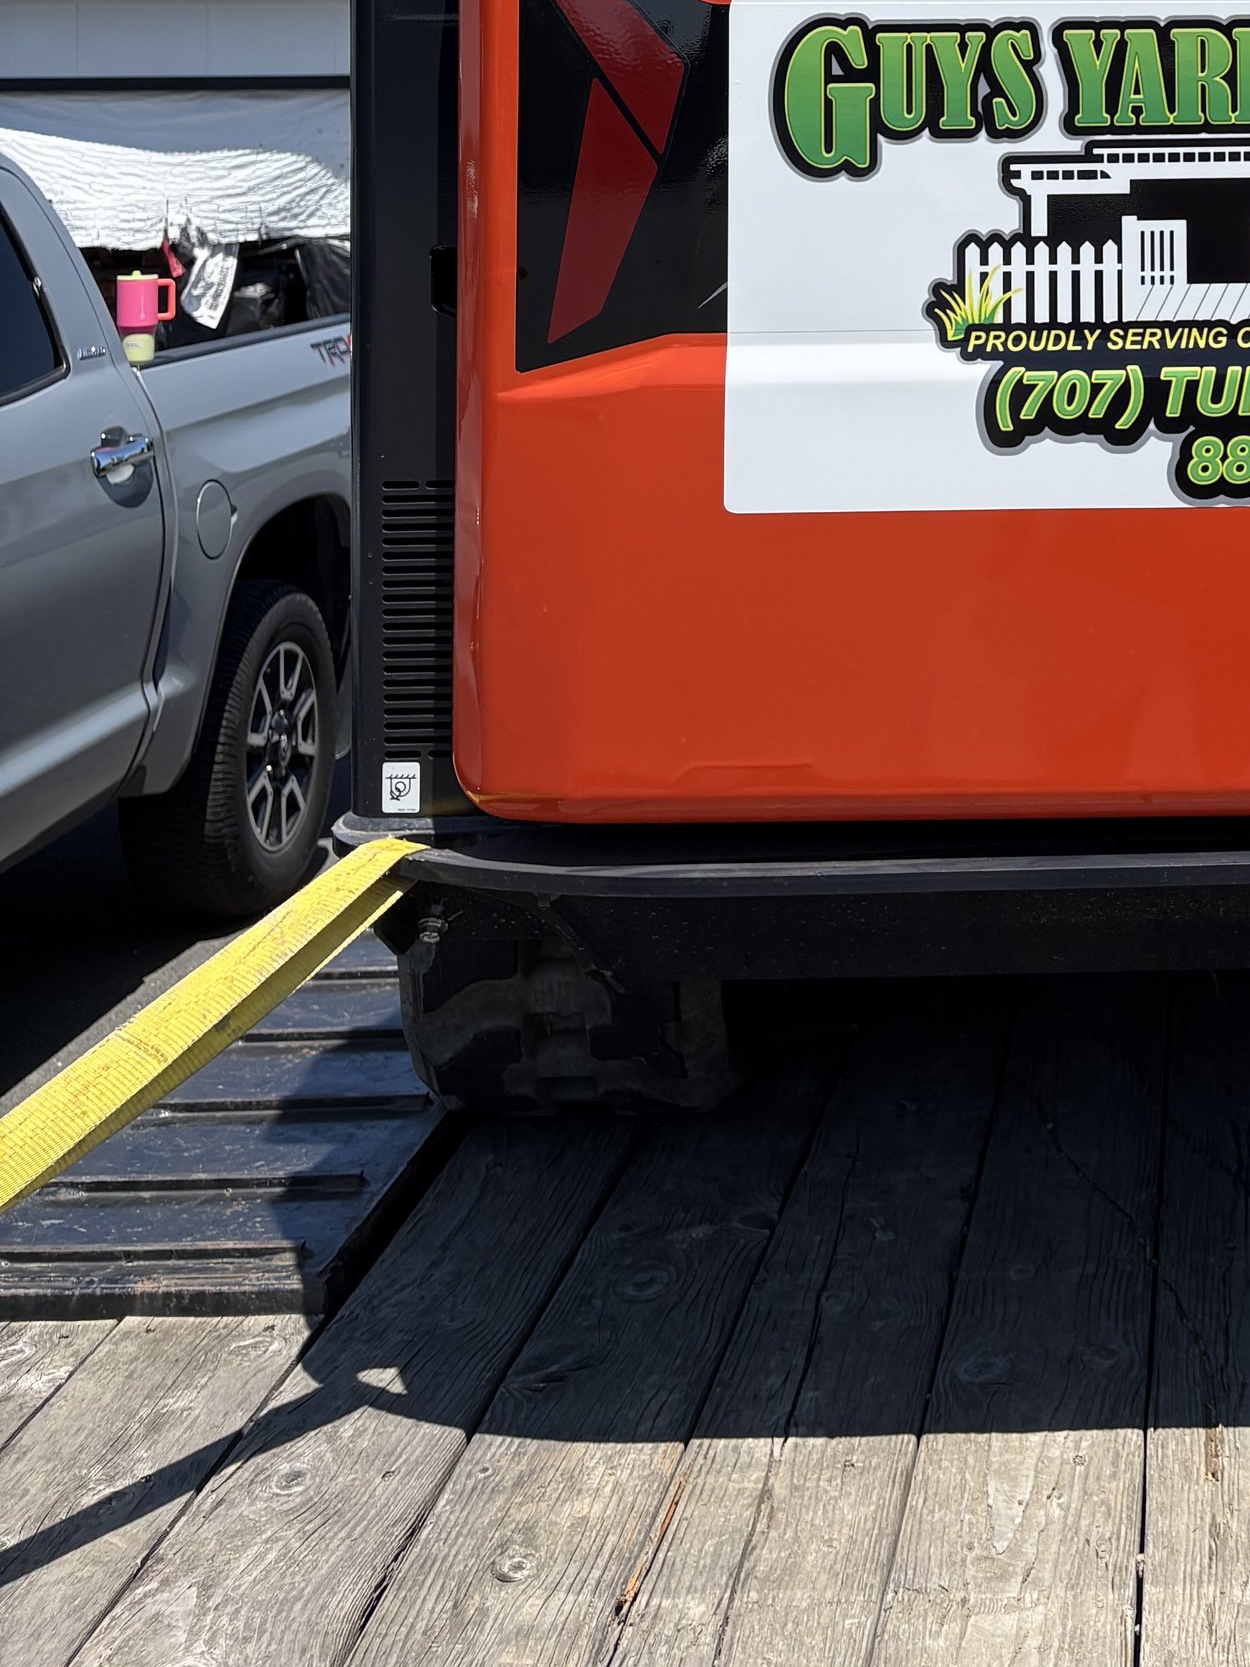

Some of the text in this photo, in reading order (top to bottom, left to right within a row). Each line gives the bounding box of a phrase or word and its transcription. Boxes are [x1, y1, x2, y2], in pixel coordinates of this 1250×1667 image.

[784, 25, 1036, 168] GUYS
[967, 329, 1102, 353] PROUDLY
[1106, 327, 1229, 351] SERVING
[995, 365, 1145, 431] (707)
